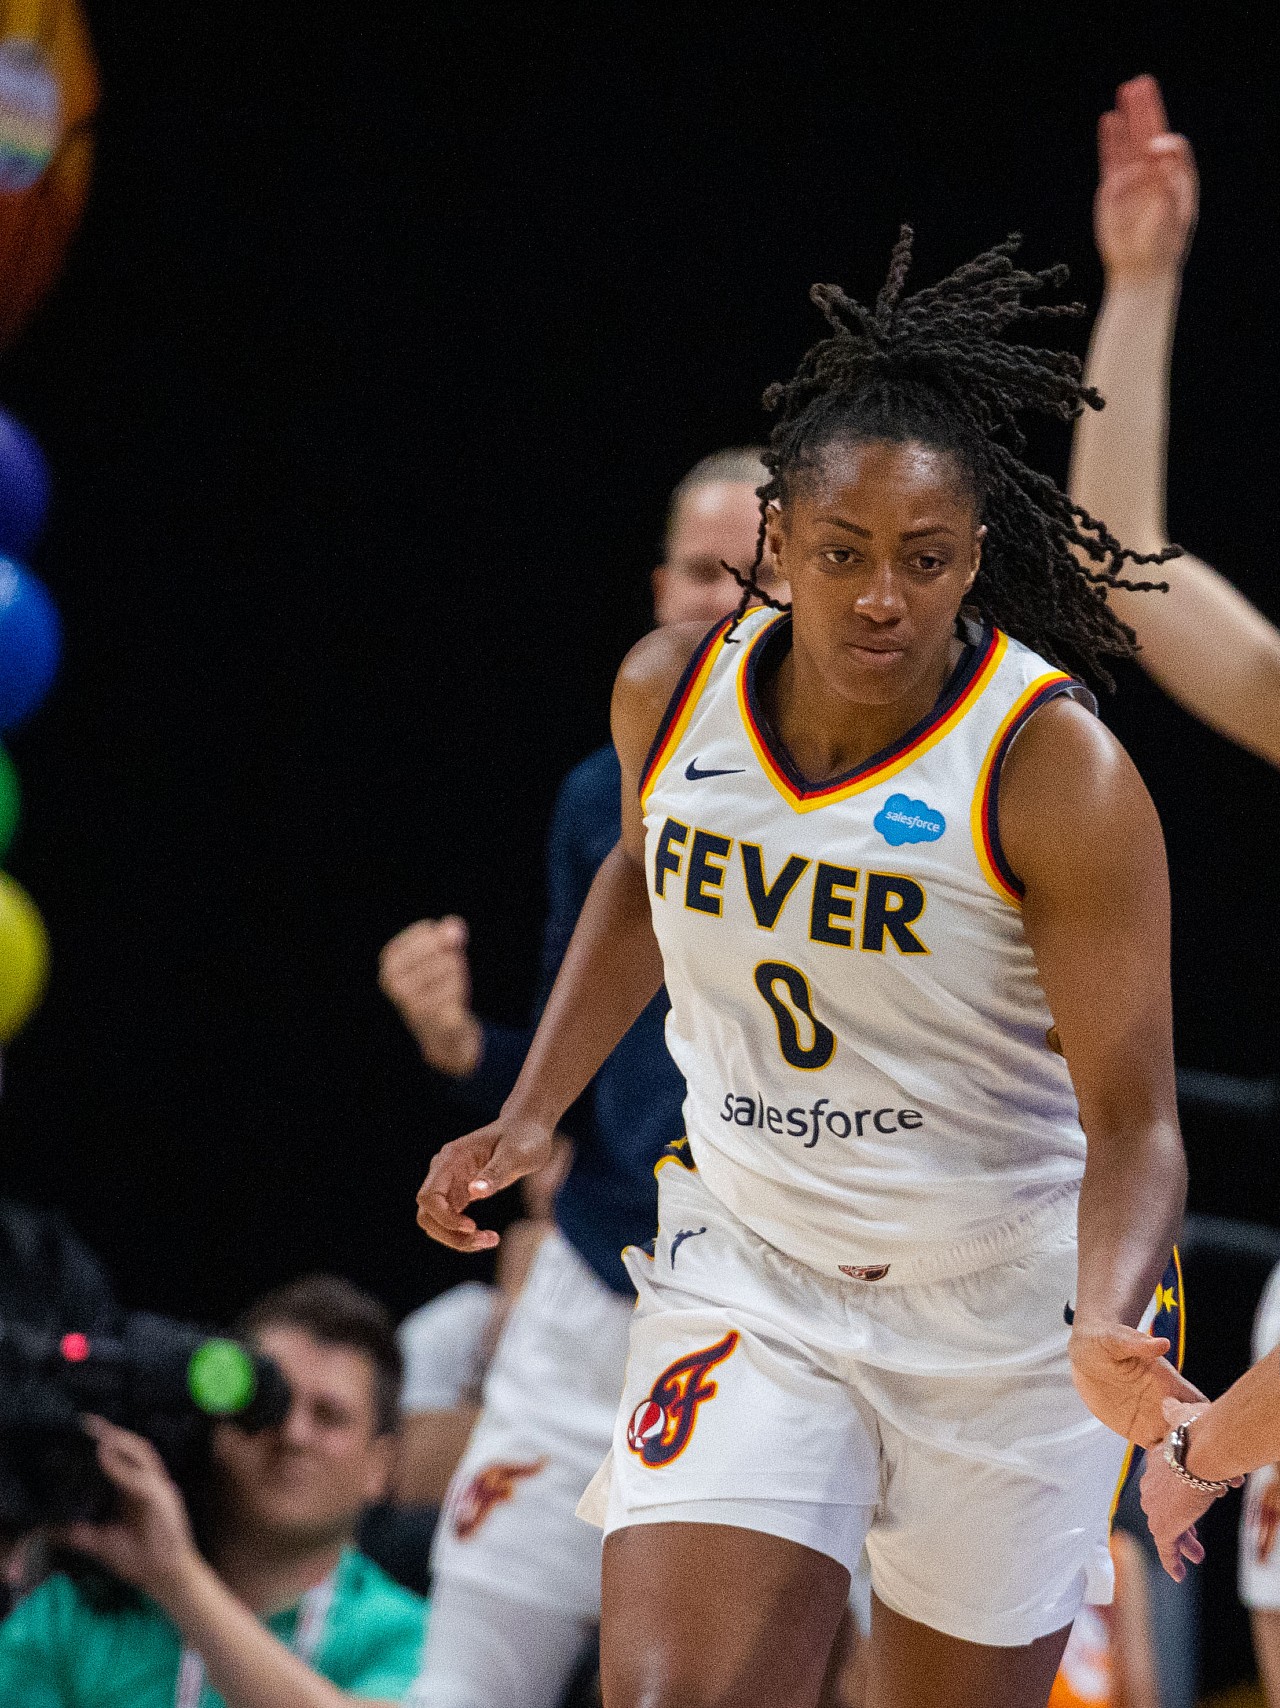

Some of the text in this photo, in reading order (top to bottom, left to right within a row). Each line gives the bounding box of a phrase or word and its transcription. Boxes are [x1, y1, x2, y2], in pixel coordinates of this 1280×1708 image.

[885, 810, 941, 833] salesforce
[654, 816, 932, 956] FEVER
[753, 959, 838, 1072] 0
[719, 1090, 924, 1148] salesforce
